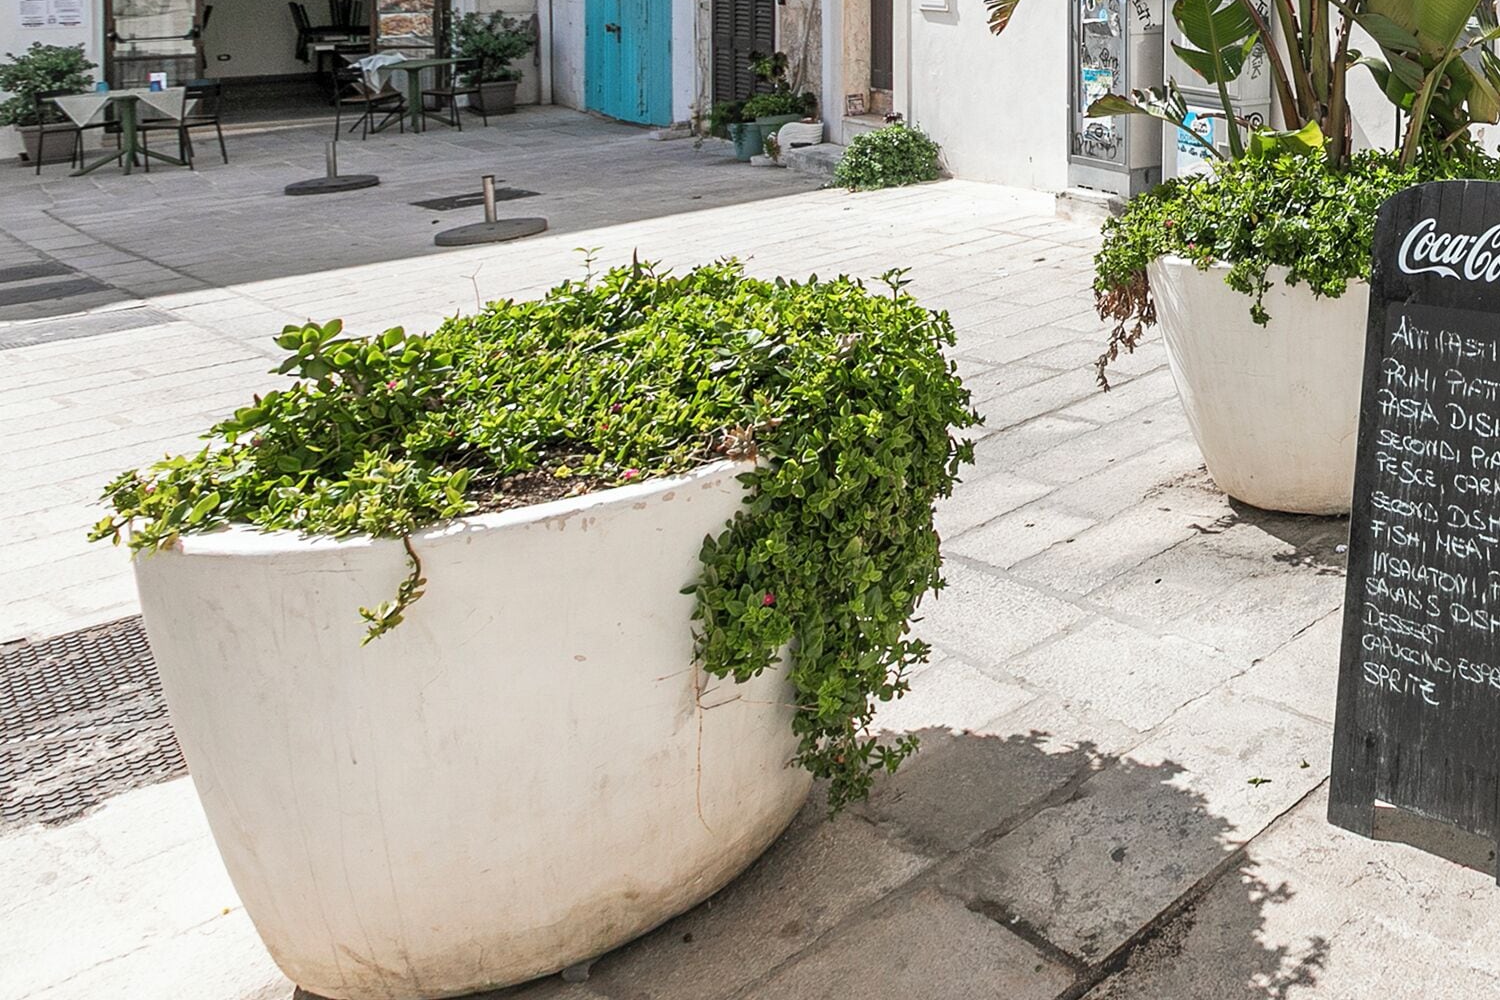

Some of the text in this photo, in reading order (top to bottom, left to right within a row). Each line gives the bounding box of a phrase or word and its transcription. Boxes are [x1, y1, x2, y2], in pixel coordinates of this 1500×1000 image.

[1382, 357, 1437, 393] PRIMI
[1376, 388, 1439, 428] PASTA
[1376, 429, 1460, 464] SECONDI
[1436, 530, 1499, 561] MEAT
